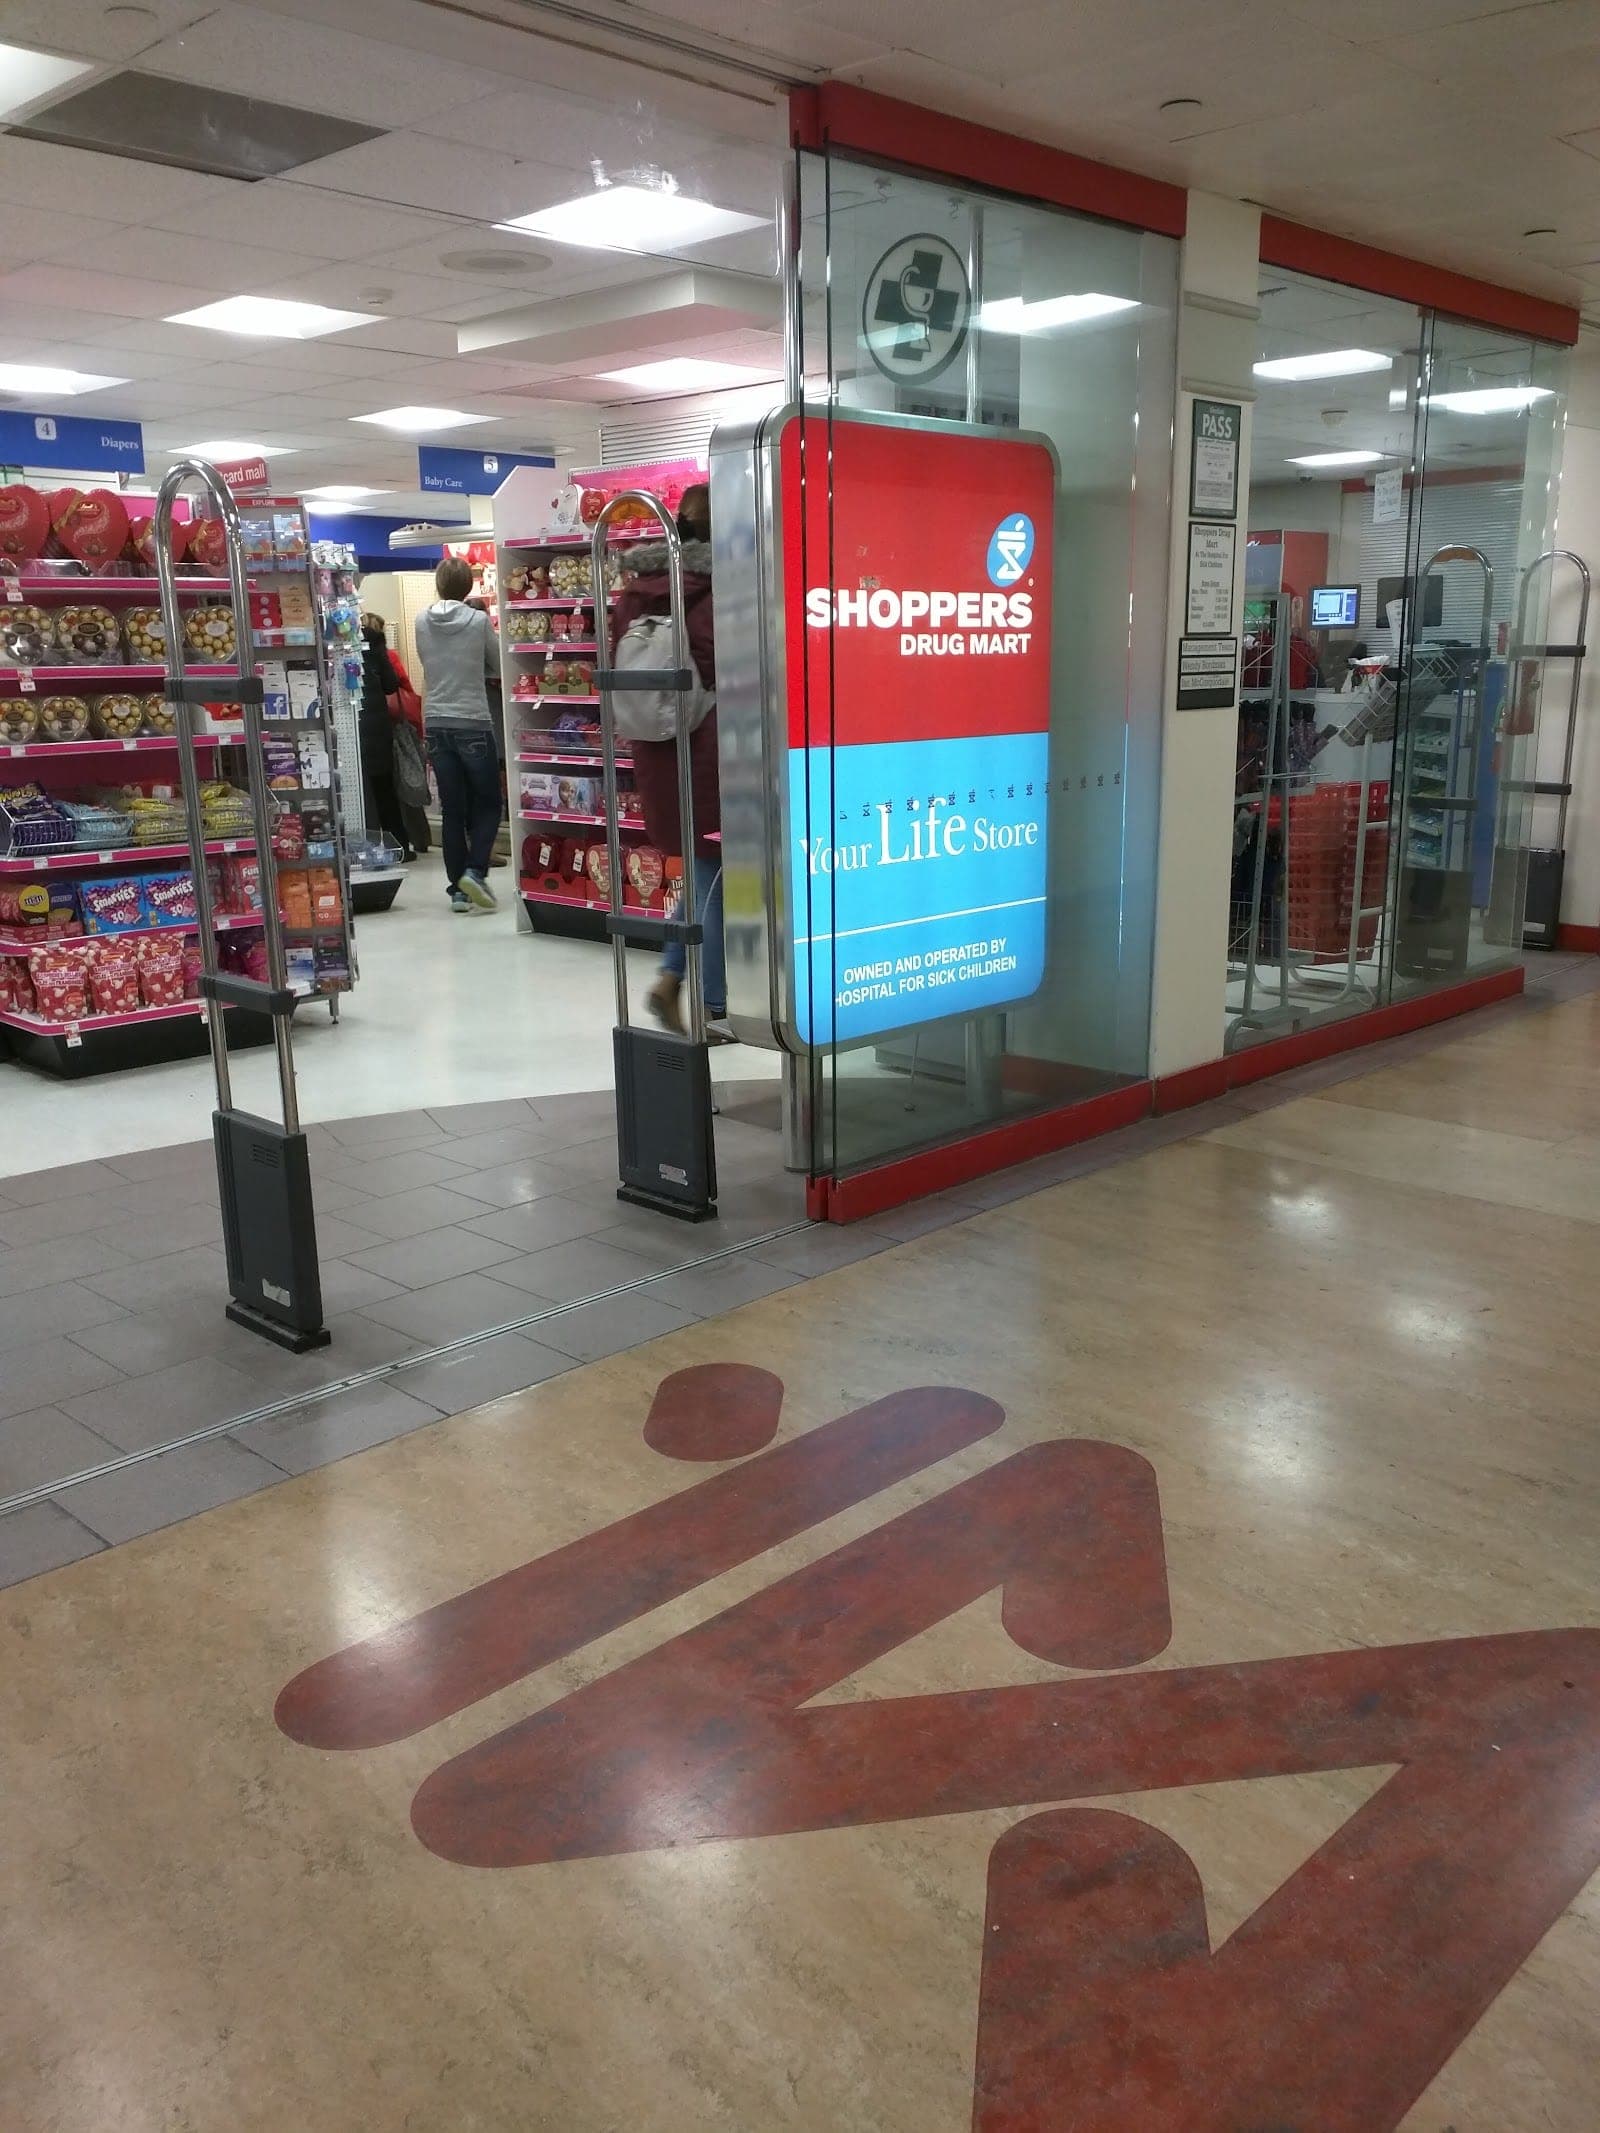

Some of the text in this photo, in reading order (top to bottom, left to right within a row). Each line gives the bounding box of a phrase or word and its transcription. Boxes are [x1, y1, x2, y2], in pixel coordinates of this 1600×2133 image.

[41, 422, 50, 436] 4
[1202, 413, 1232, 439] PASS
[100, 436, 139, 451] Diapers
[245, 463, 266, 480] mall
[424, 476, 463, 488] Baby Care
[805, 587, 1033, 628] SHOPPERS
[900, 633, 1031, 656] DRUG MART
[799, 796, 1038, 875] Your Life Store
[111, 910, 125, 924] 30
[170, 903, 183, 917] 30
[844, 937, 1007, 985] OWNED AND OPERATED BY
[835, 955, 1017, 1008] HOSPITAL FOR SICK CHILDREN
